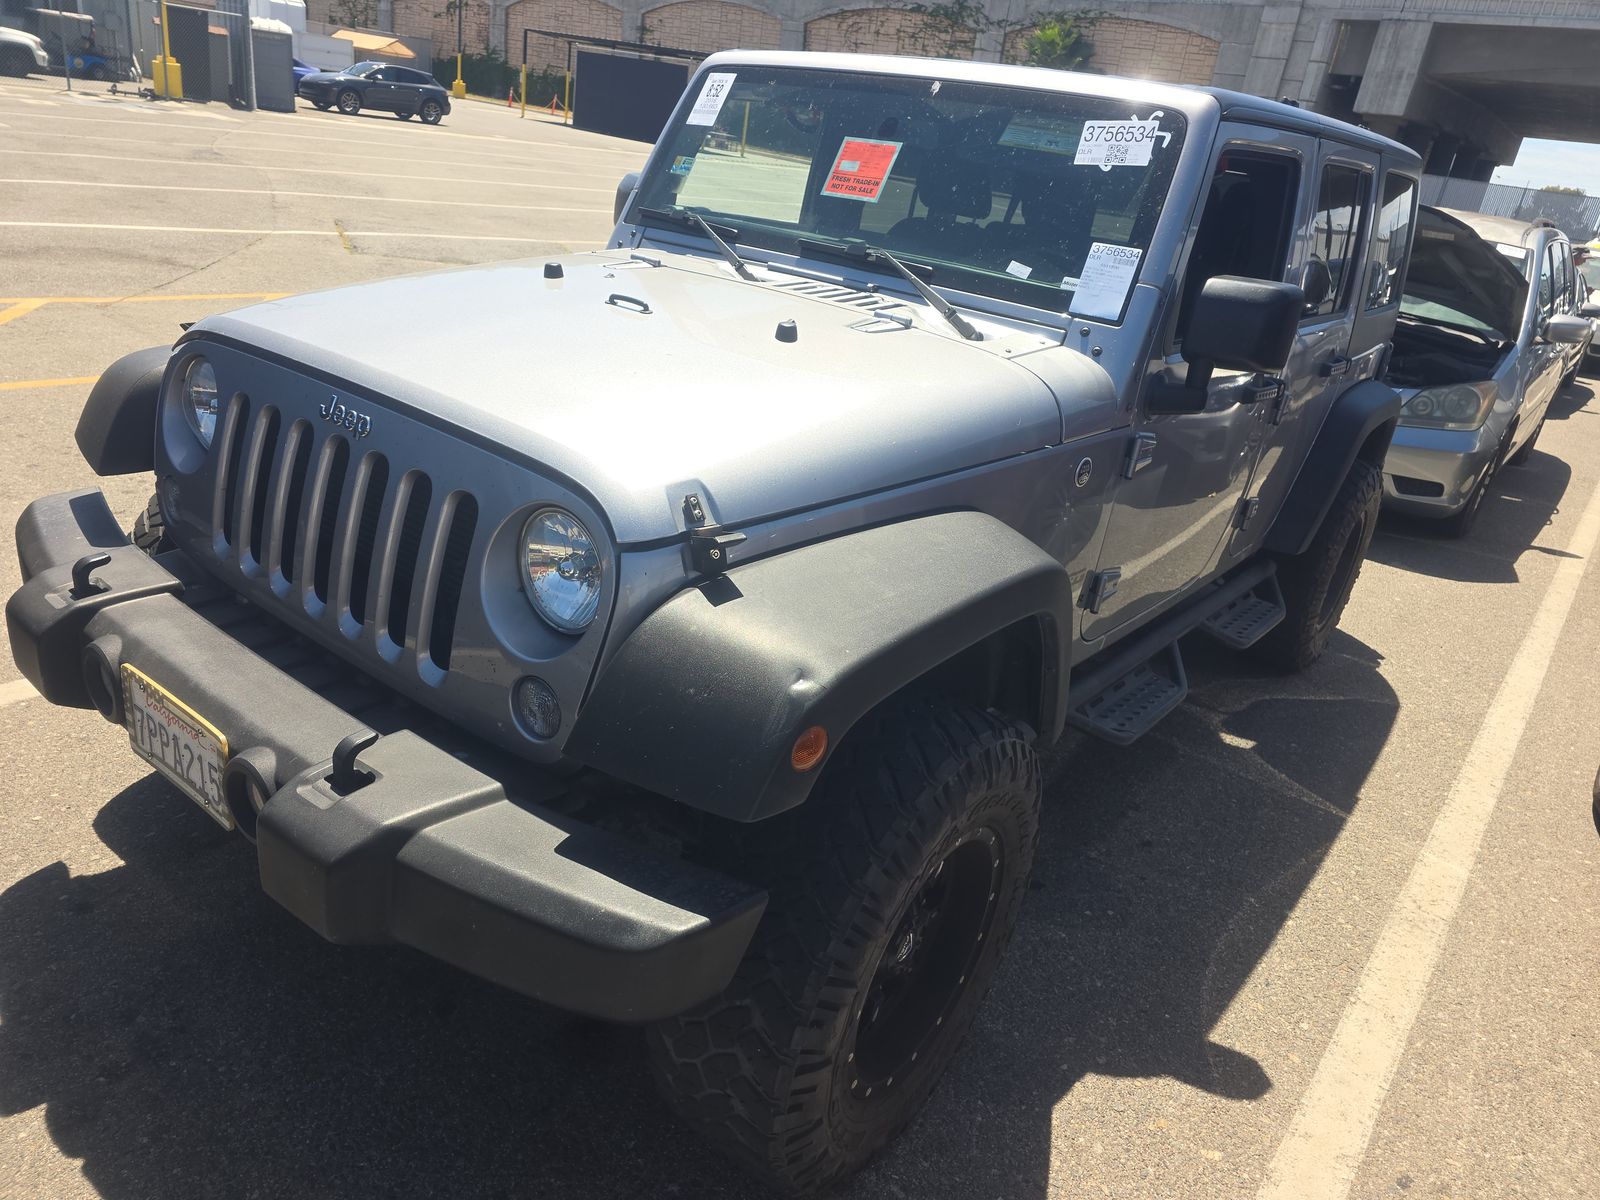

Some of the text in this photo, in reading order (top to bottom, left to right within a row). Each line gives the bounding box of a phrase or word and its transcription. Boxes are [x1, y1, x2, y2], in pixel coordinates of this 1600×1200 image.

[1084, 126, 1156, 142] 3756534
[832, 175, 881, 187] FRESH TRADE-IN
[1093, 245, 1140, 260] 3756534
[320, 394, 371, 440] Jeep
[145, 691, 205, 746] California
[133, 704, 222, 807] 7PPA215
